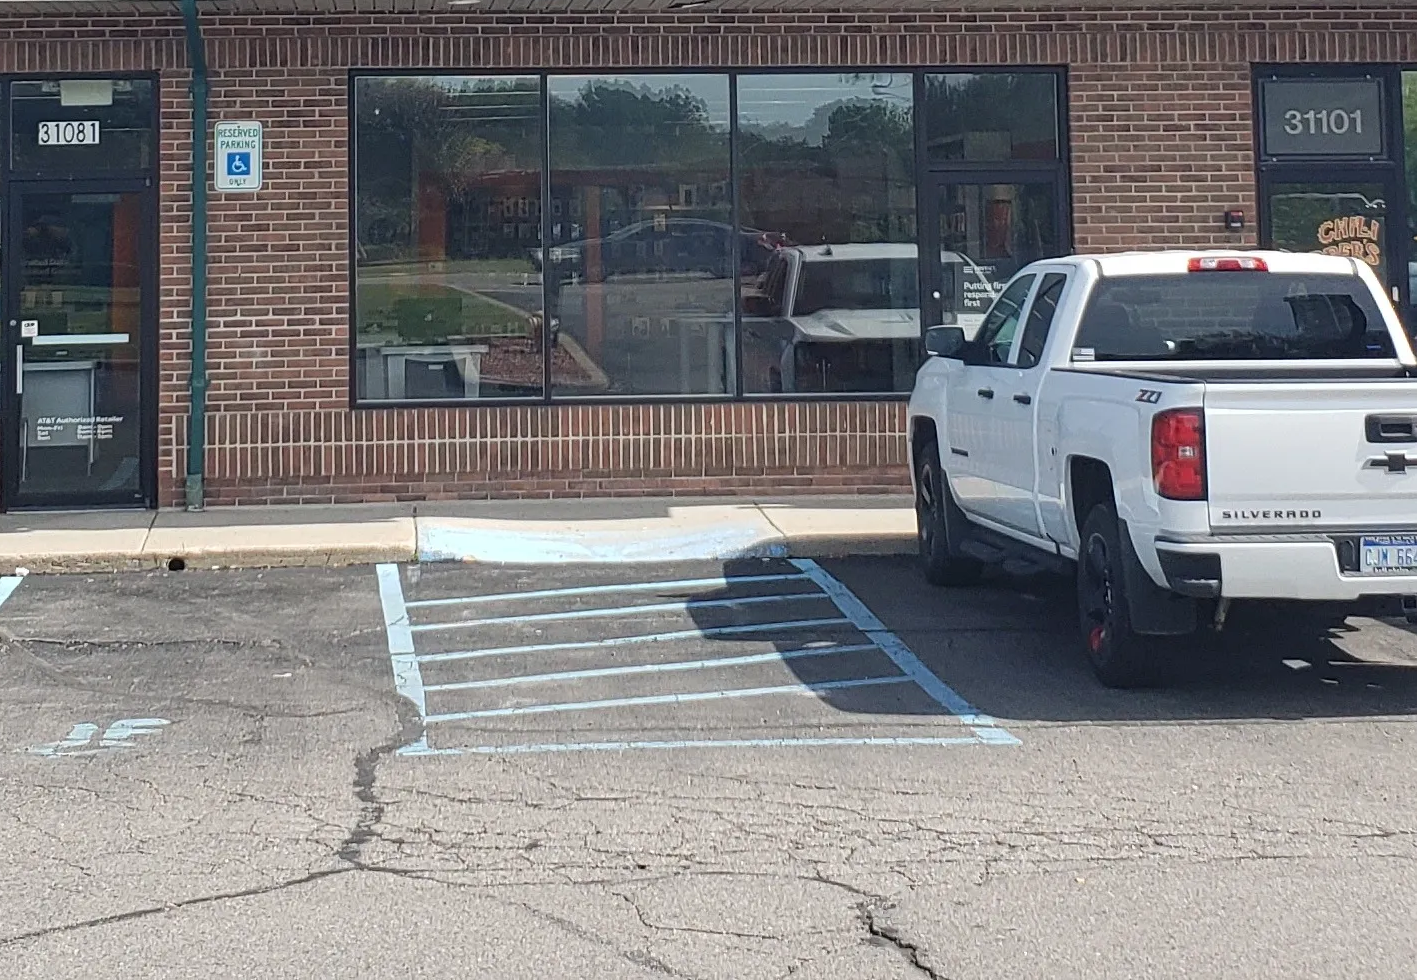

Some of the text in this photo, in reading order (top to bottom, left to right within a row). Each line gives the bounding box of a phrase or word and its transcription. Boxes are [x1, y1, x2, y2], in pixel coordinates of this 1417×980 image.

[1284, 109, 1362, 135] 31101
[41, 122, 96, 143] 31081
[218, 128, 258, 138] RESERVED
[220, 140, 256, 150] PARKING
[229, 178, 247, 186] ONLY
[1317, 215, 1380, 245] CHILI
[963, 298, 981, 307] first
[56, 416, 95, 424] Authorized
[1222, 510, 1322, 519] SILVERADO
